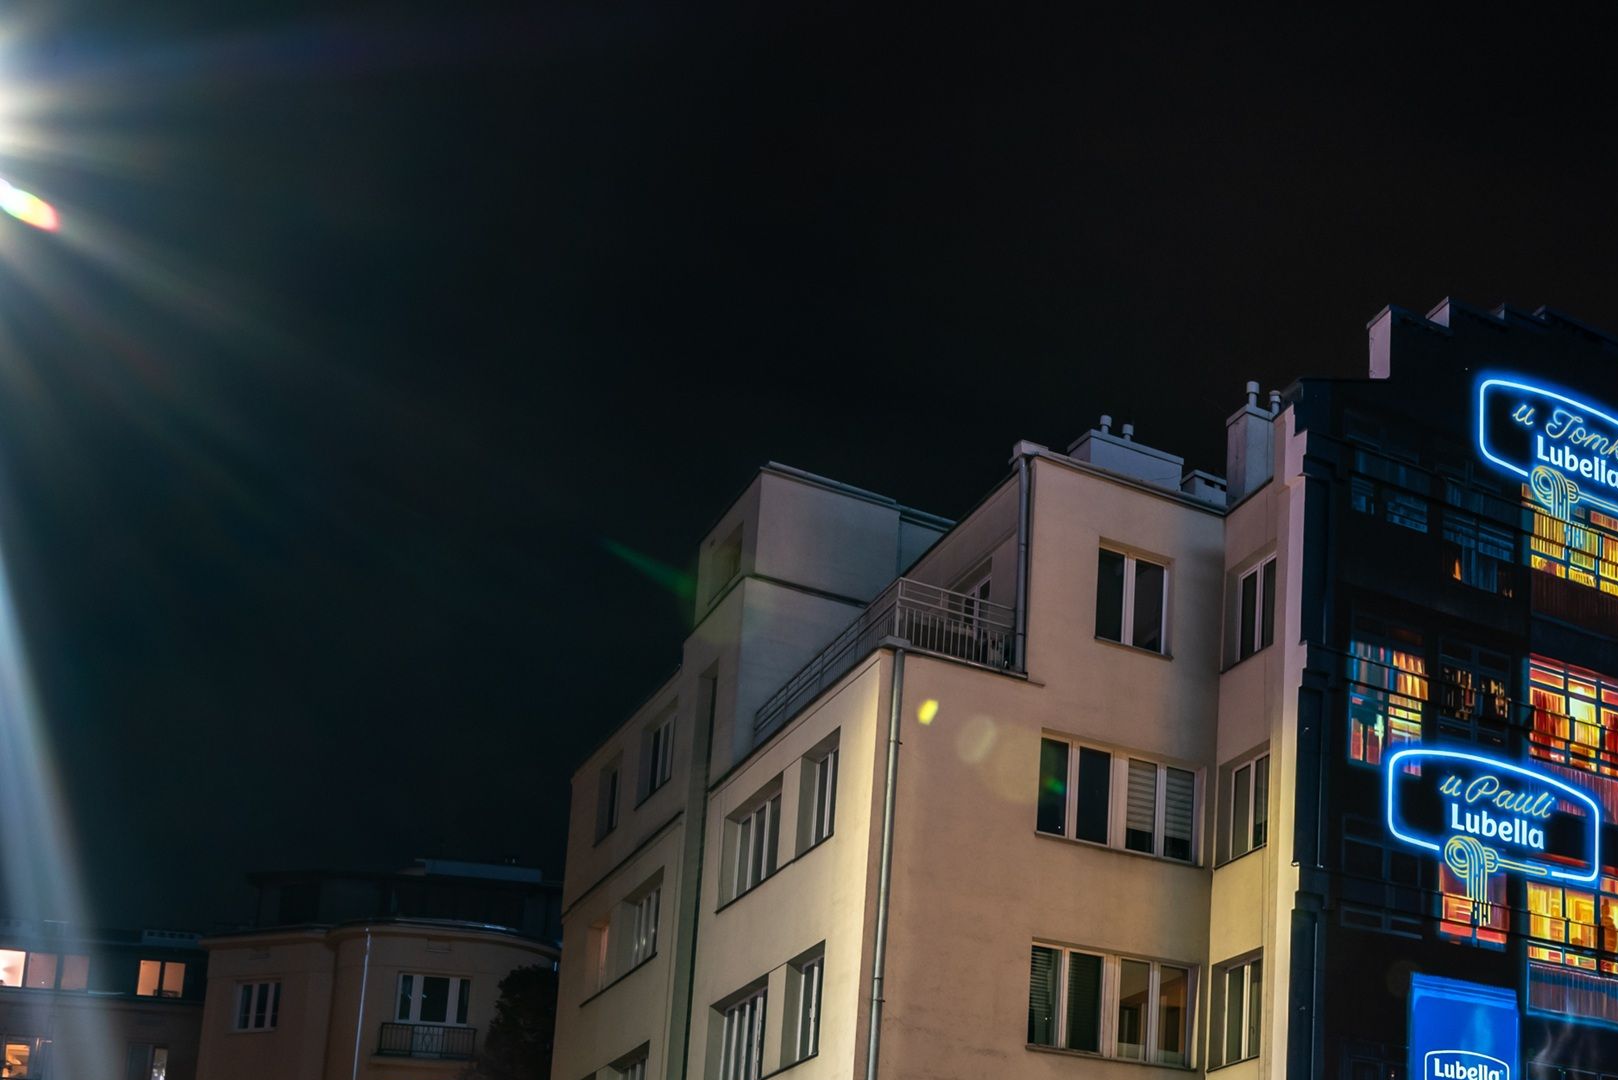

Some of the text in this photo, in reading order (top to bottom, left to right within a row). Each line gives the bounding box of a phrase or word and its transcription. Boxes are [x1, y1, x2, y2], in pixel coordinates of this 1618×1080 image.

[1512, 405, 1535, 426] u
[1440, 775, 1555, 819] u Pauli
[1451, 803, 1545, 850] Lubella
